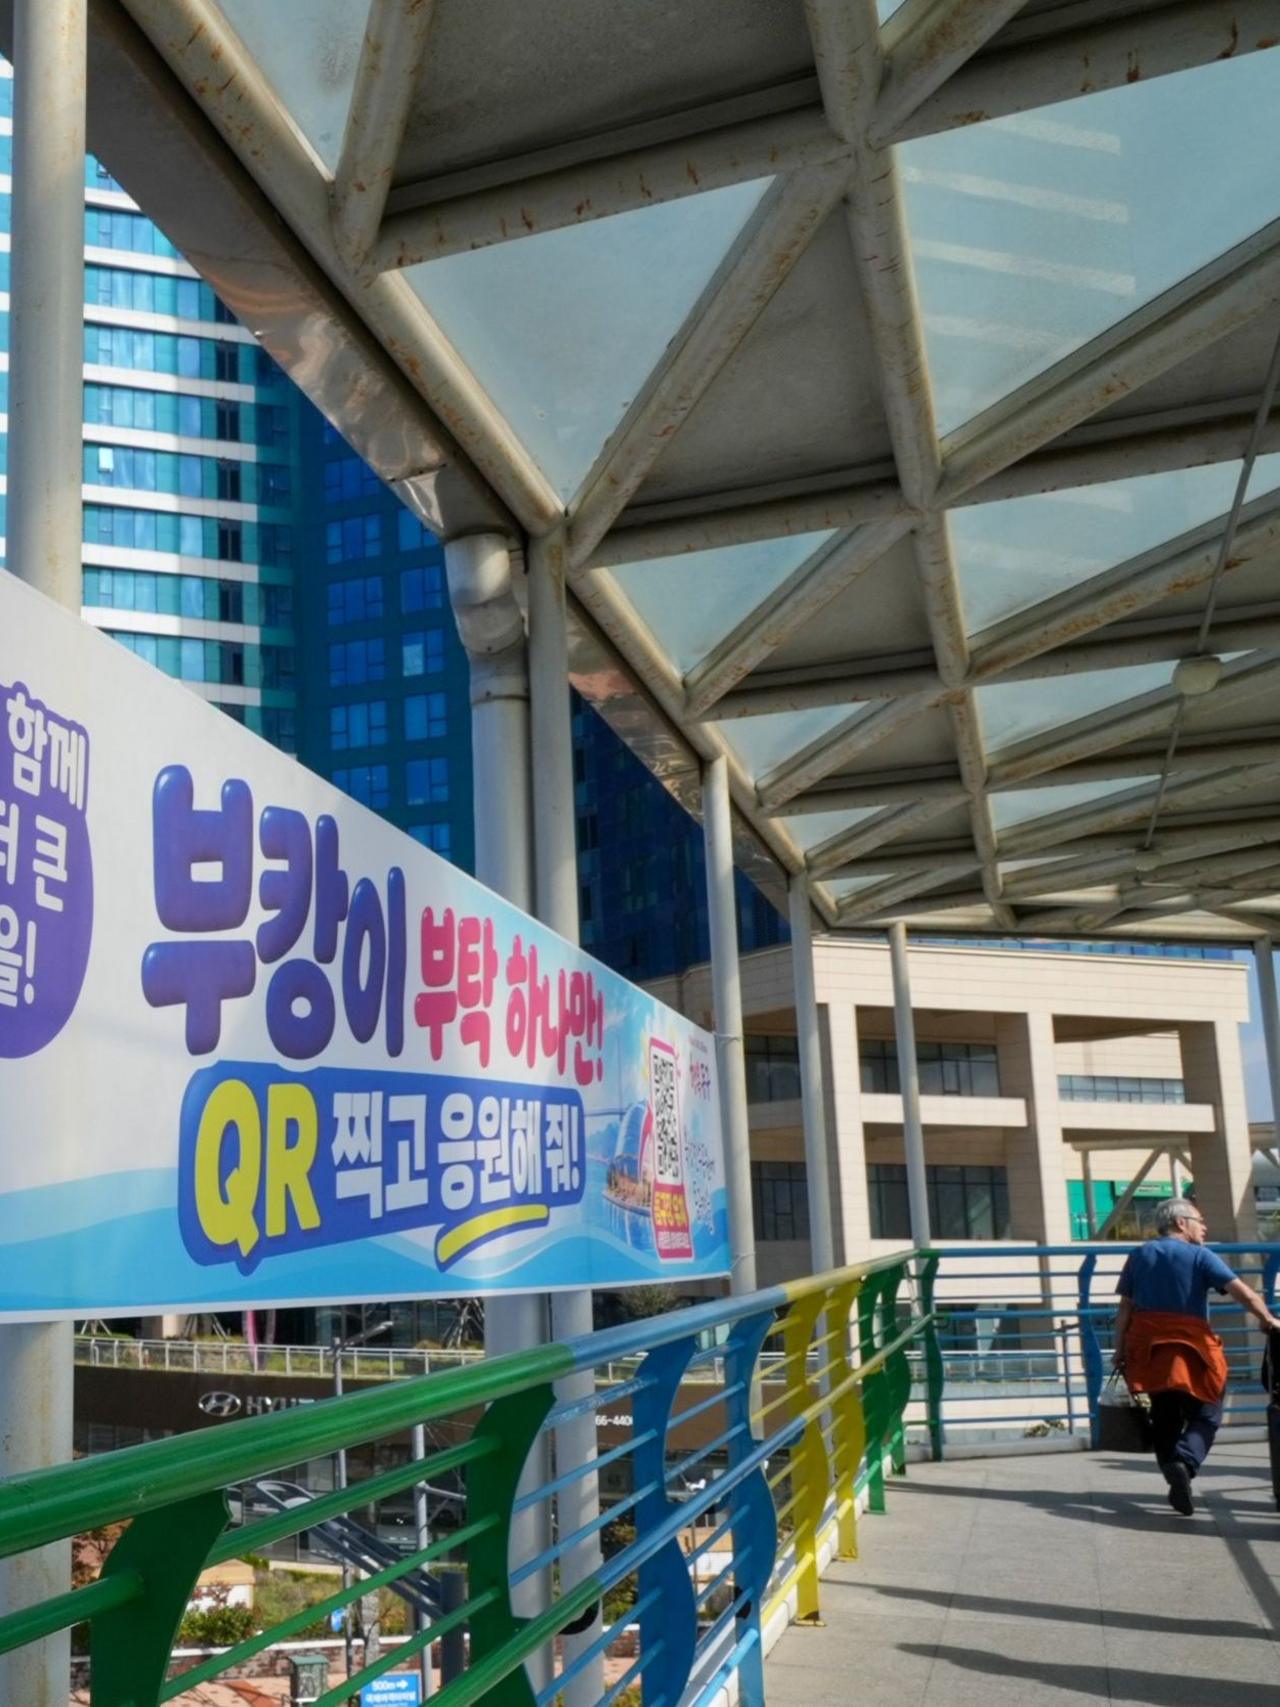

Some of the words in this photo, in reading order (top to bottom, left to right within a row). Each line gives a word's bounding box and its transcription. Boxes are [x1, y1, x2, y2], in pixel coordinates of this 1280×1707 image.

[7, 693, 86, 809] 함께
[33, 814, 68, 912] 큰
[141, 764, 407, 1060] 부캉이
[414, 906, 498, 1068] 부탁
[505, 934, 605, 1086] 하나만!
[195, 1078, 321, 1258] QR
[331, 1091, 428, 1219] 찍고
[437, 1092, 541, 1210] 응원해
[545, 1103, 581, 1193] 줘!
